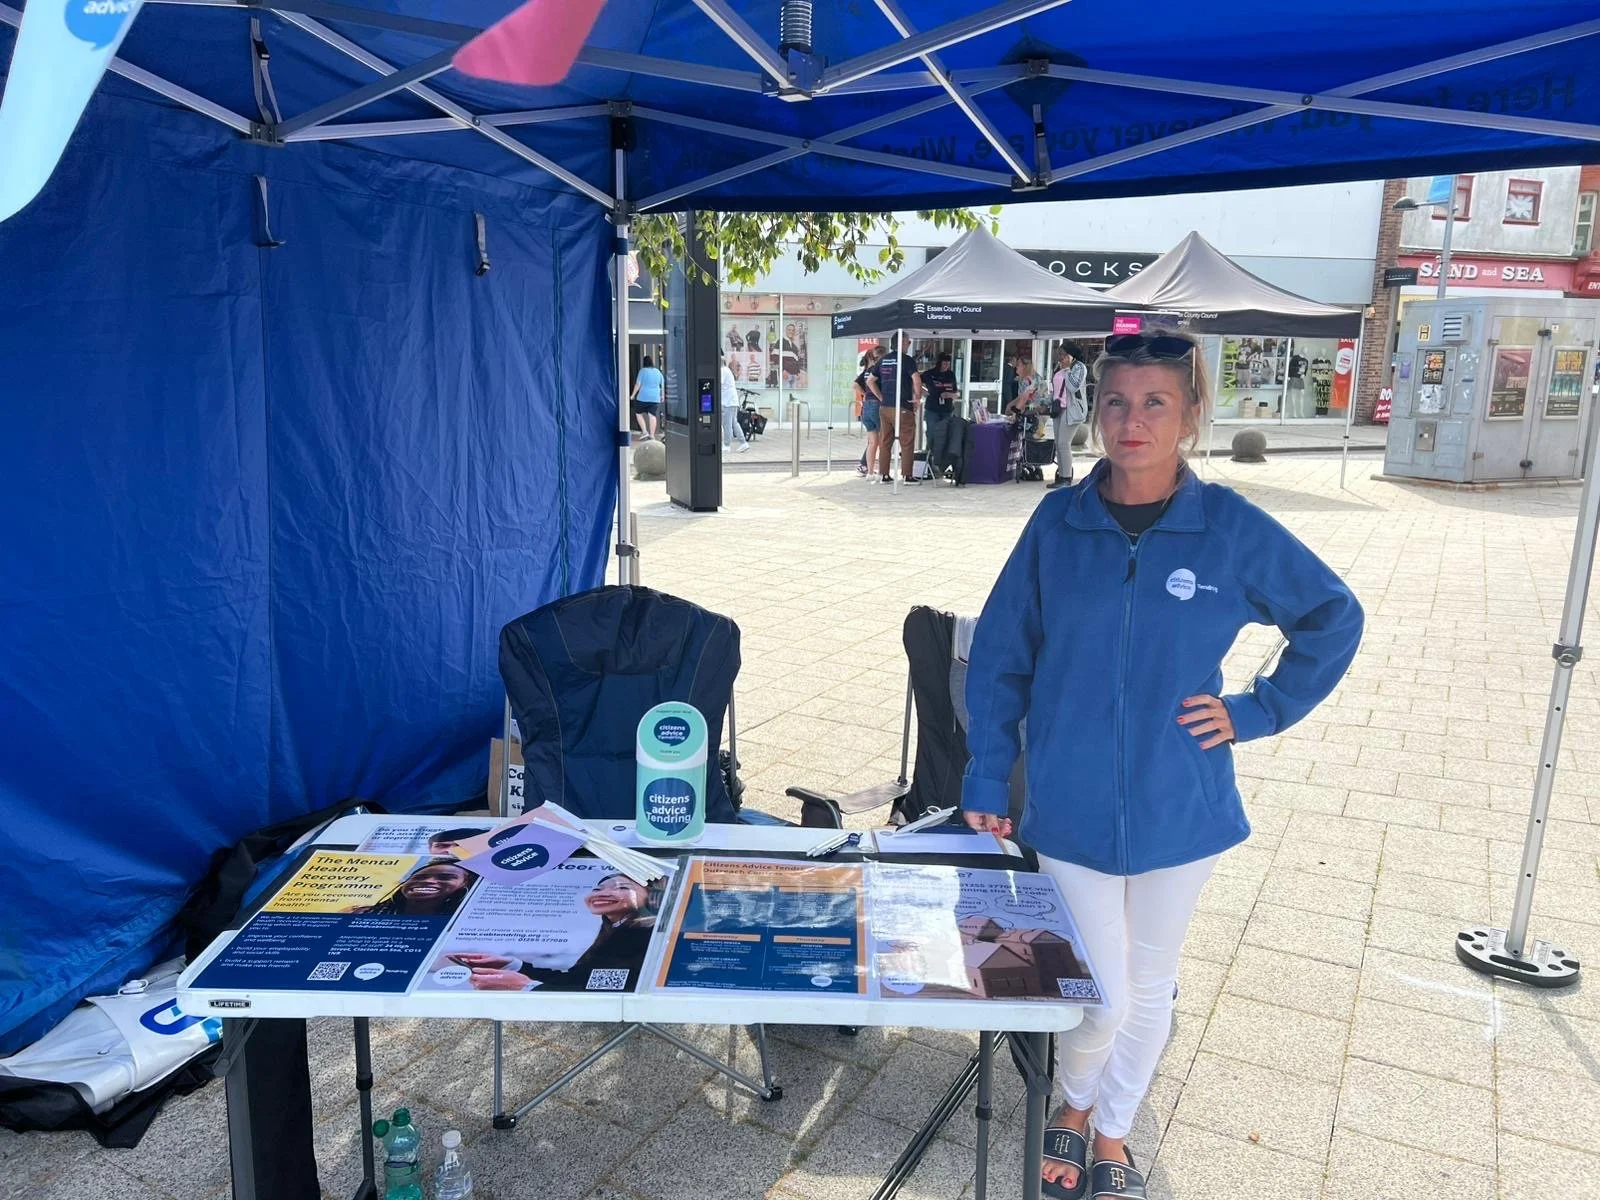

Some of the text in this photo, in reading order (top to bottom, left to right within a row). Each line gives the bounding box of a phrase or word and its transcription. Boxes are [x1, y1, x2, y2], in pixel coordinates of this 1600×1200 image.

[1030, 260, 1143, 276] OCKS
[1482, 268, 1497, 276] and
[1502, 266, 1544, 281] SEA
[943, 306, 962, 314] County
[963, 306, 981, 314] Council
[649, 793, 690, 804] citizens
[652, 805, 687, 815] advice
[646, 811, 692, 824] Tendring
[316, 856, 400, 866] The Mental
[500, 847, 533, 865] citizens
[510, 852, 539, 867] advice
[308, 865, 359, 873] Health
[301, 873, 370, 882] Recovery
[293, 881, 383, 890] Programme
